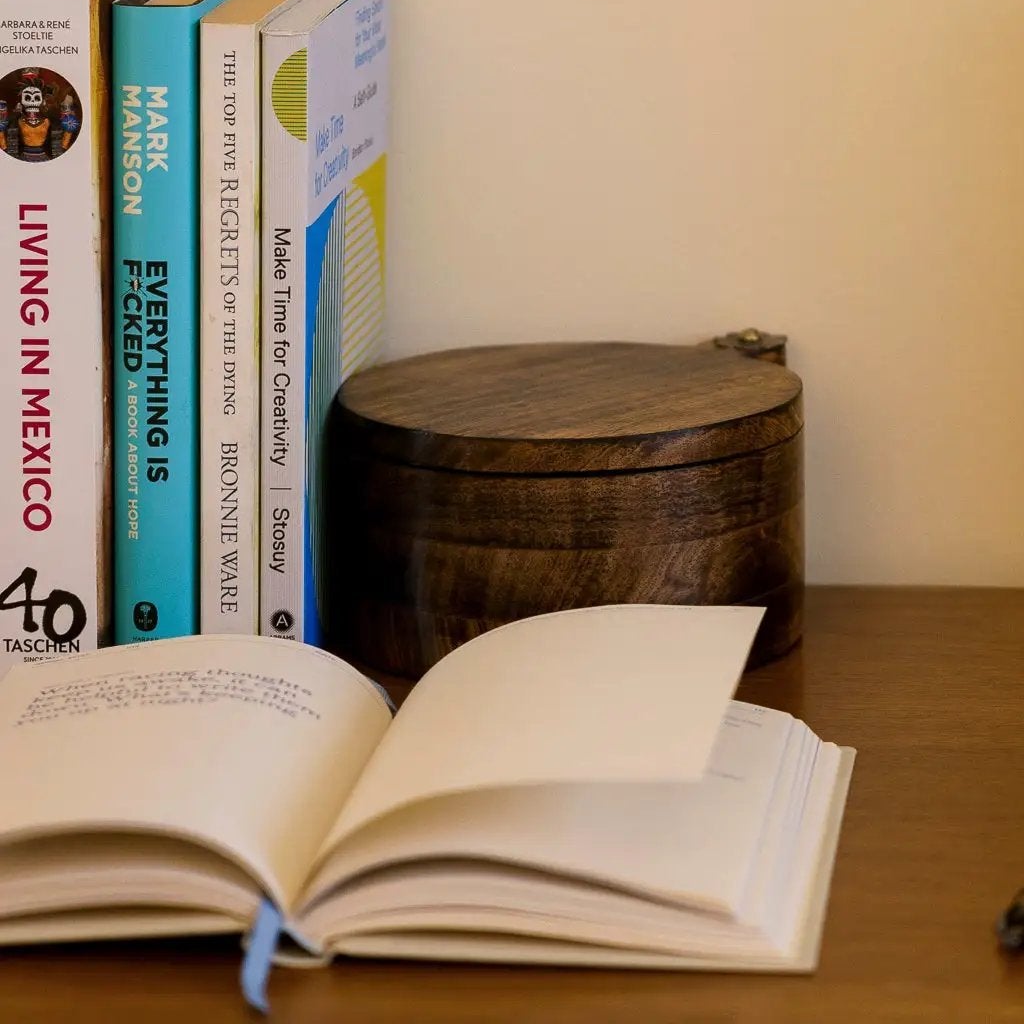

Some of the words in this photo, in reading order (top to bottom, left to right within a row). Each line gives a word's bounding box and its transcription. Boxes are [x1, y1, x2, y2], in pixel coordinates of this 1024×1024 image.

[12, 31, 54, 41] STOELTIE
[39, 21, 45, 29] &
[46, 19, 71, 29] RENÉ
[36, 46, 79, 55] TASCHEN
[223, 51, 236, 87] THE
[146, 86, 168, 172] MARK
[223, 92, 236, 126] TOP
[122, 85, 142, 215] MANSON
[223, 132, 236, 171] FIVE
[220, 177, 239, 286] REGRETS
[274, 228, 291, 280] Make
[19, 204, 50, 326] LIVING
[223, 291, 236, 314] OF
[273, 286, 290, 333] Time
[21, 339, 50, 374] IN
[146, 261, 169, 448] EVERYTHING
[223, 319, 236, 355] THE
[273, 339, 290, 367] for
[127, 379, 138, 390] A
[223, 360, 236, 416] DYING
[127, 395, 138, 438] BOOK
[270, 373, 291, 466] Creativity
[22, 389, 52, 532] MEXICO
[127, 442, 138, 495] ABOUT
[146, 457, 169, 483] IS
[220, 442, 239, 544] BRONNIE
[128, 499, 139, 540] HOPE
[270, 508, 290, 574] Stosuy
[220, 549, 238, 614] WARE
[0, 566, 87, 644] 40
[3, 638, 80, 653] TASCHEN
